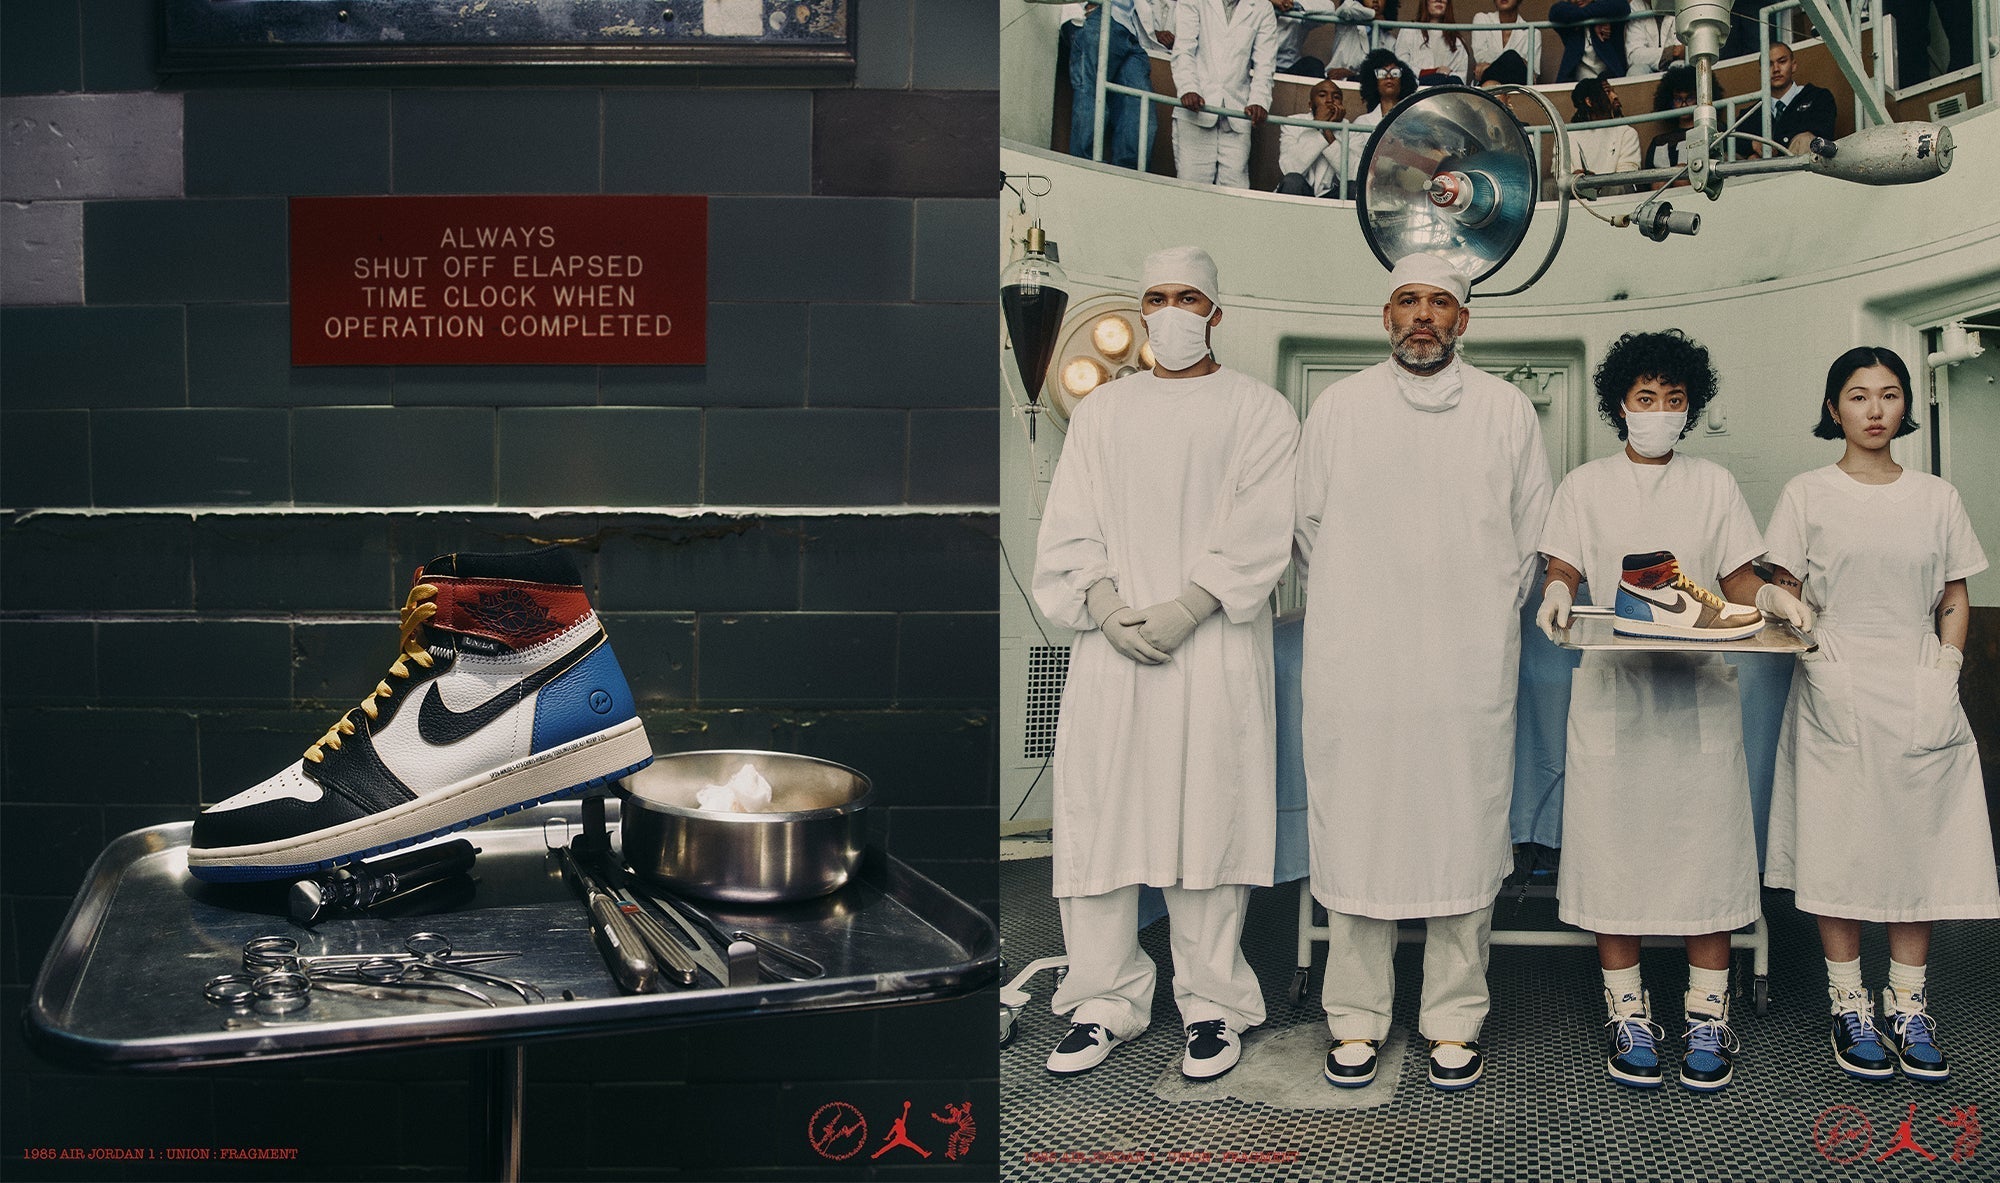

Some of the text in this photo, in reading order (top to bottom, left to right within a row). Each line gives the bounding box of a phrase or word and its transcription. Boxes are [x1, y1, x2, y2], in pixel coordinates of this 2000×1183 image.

[440, 226, 555, 248] ALWAYS
[354, 255, 643, 279] SHUT OFF ELAPSED
[361, 285, 635, 308] TIME CLOCK WHEN
[325, 315, 672, 339] OPERATION COMPLETED
[484, 589, 547, 618] AIR JORDAN
